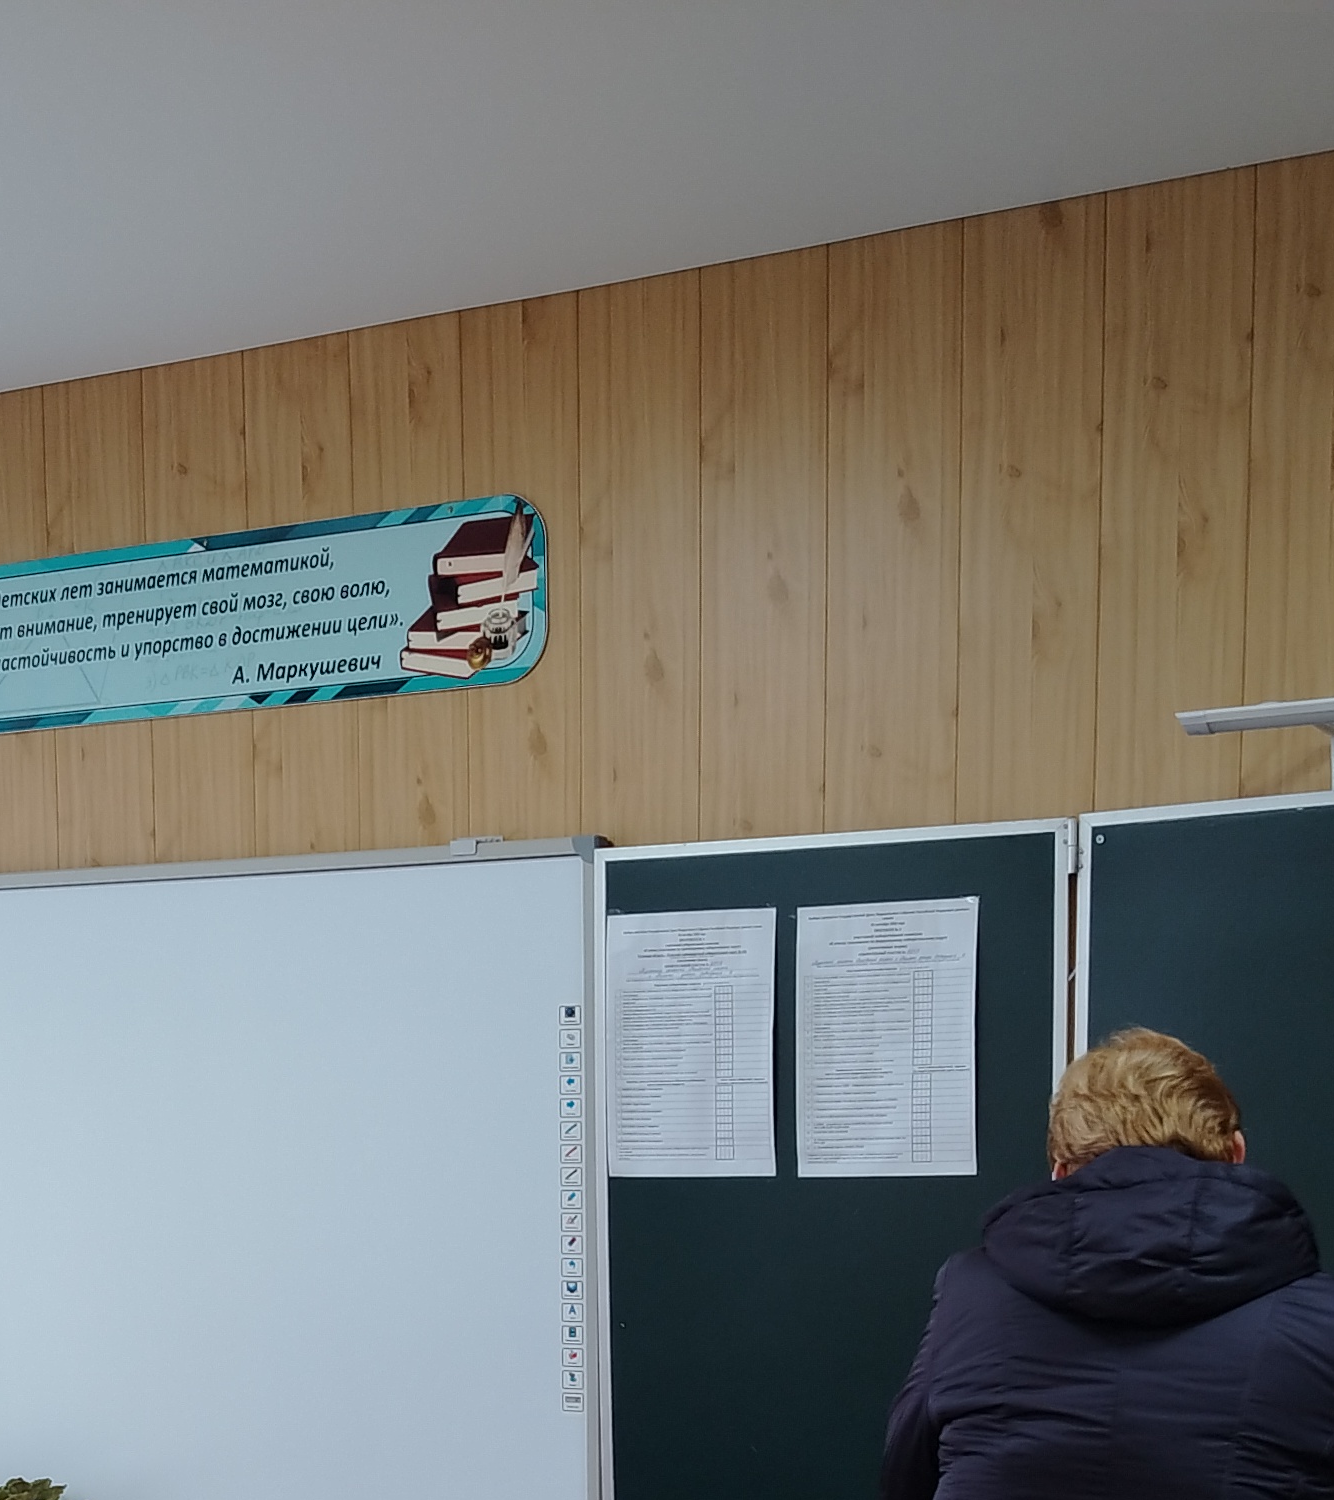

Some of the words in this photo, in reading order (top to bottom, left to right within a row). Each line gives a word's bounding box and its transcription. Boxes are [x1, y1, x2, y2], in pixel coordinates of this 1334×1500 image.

[59, 583, 93, 601] лет
[96, 569, 198, 596] занимается
[201, 546, 334, 583] математикой,
[17, 615, 98, 638] внимание,
[102, 603, 197, 631] тренирует
[201, 592, 239, 616] свой
[242, 592, 287, 611] мозг,
[292, 586, 335, 605] свою
[339, 580, 390, 600] волю,
[121, 643, 130, 658] и
[134, 634, 214, 661] упорство
[218, 632, 228, 647] в
[231, 619, 342, 646] достижении
[231, 665, 250, 685] А.
[256, 655, 382, 684] Маркушевич
